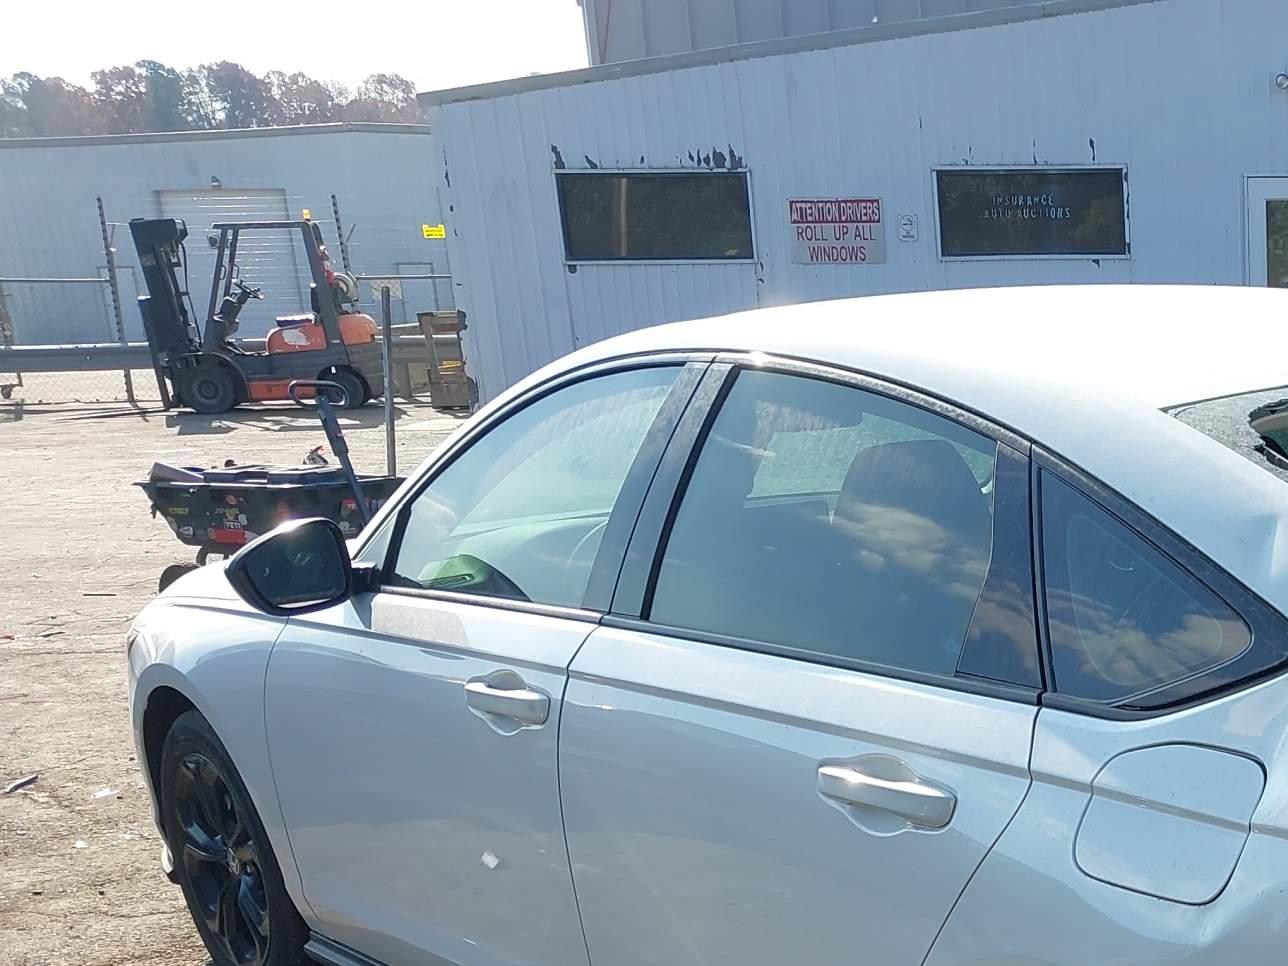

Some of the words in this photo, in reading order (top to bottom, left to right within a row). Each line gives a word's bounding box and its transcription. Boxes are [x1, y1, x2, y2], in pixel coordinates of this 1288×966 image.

[791, 202, 840, 222] ATTENTION
[840, 202, 880, 221] DRIVERS
[796, 225, 828, 241] ROLL
[834, 225, 849, 241] UP
[854, 225, 876, 240] ALL
[808, 246, 867, 262] WINDOWS
[225, 521, 242, 530] YETI
